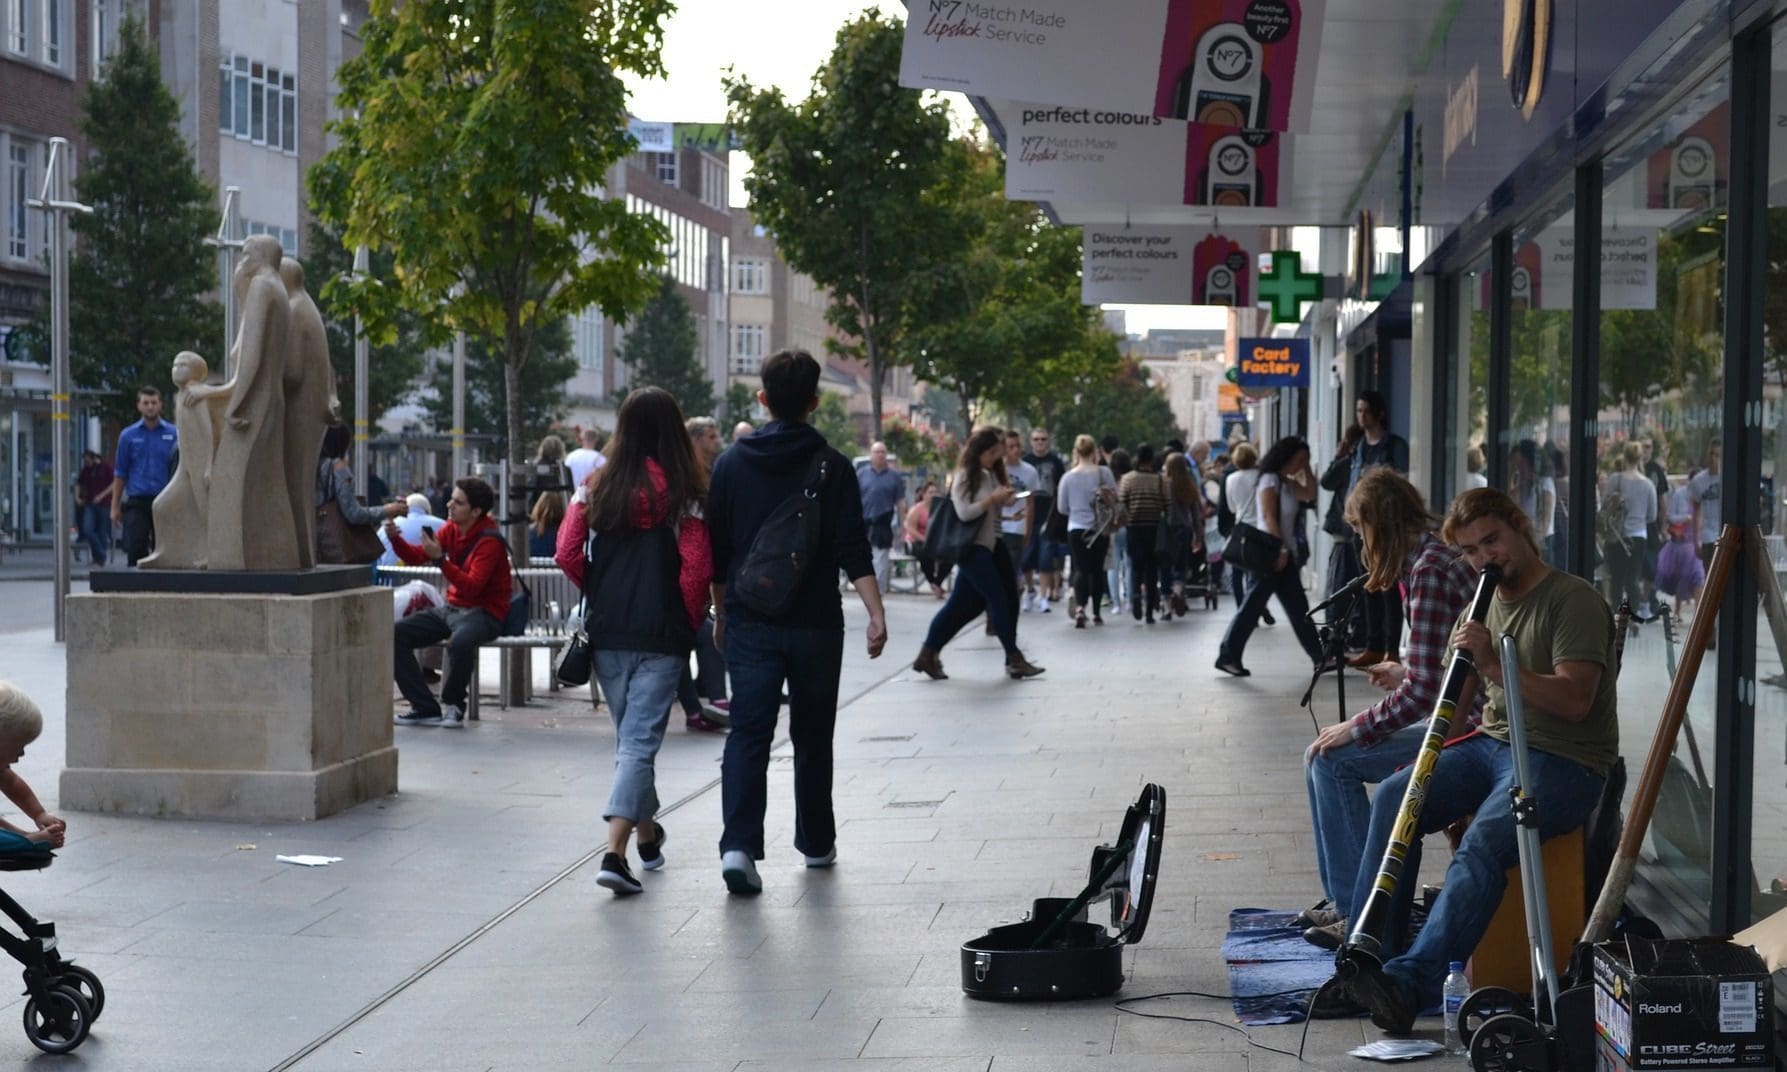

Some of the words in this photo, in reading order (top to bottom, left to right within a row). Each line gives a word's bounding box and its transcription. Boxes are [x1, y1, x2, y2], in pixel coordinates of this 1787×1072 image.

[1254, 3, 1285, 13] Another
[965, 3, 1016, 22] Match
[1020, 9, 1066, 28] Made
[1274, 15, 1289, 24] first
[986, 24, 1046, 45] Service
[1022, 106, 1090, 125] perfect
[1046, 136, 1083, 149] Match
[1086, 138, 1117, 150] Made
[1062, 151, 1105, 162] Service
[1092, 233, 1143, 245] Discover
[1146, 235, 1171, 247] your
[1092, 248, 1134, 260] perfect
[1136, 249, 1178, 260] colours
[1253, 346, 1290, 361] Card
[1242, 360, 1300, 377] Factory
[1639, 1003, 1682, 1014] Roland
[1640, 1044, 1692, 1055] CUBE
[1692, 1041, 1736, 1056] Street
[1640, 1057, 1661, 1067] Battery
[1662, 1057, 1688, 1065] Powered
[1689, 1057, 1708, 1065] Stereo
[1709, 1055, 1736, 1065] Amplifier
